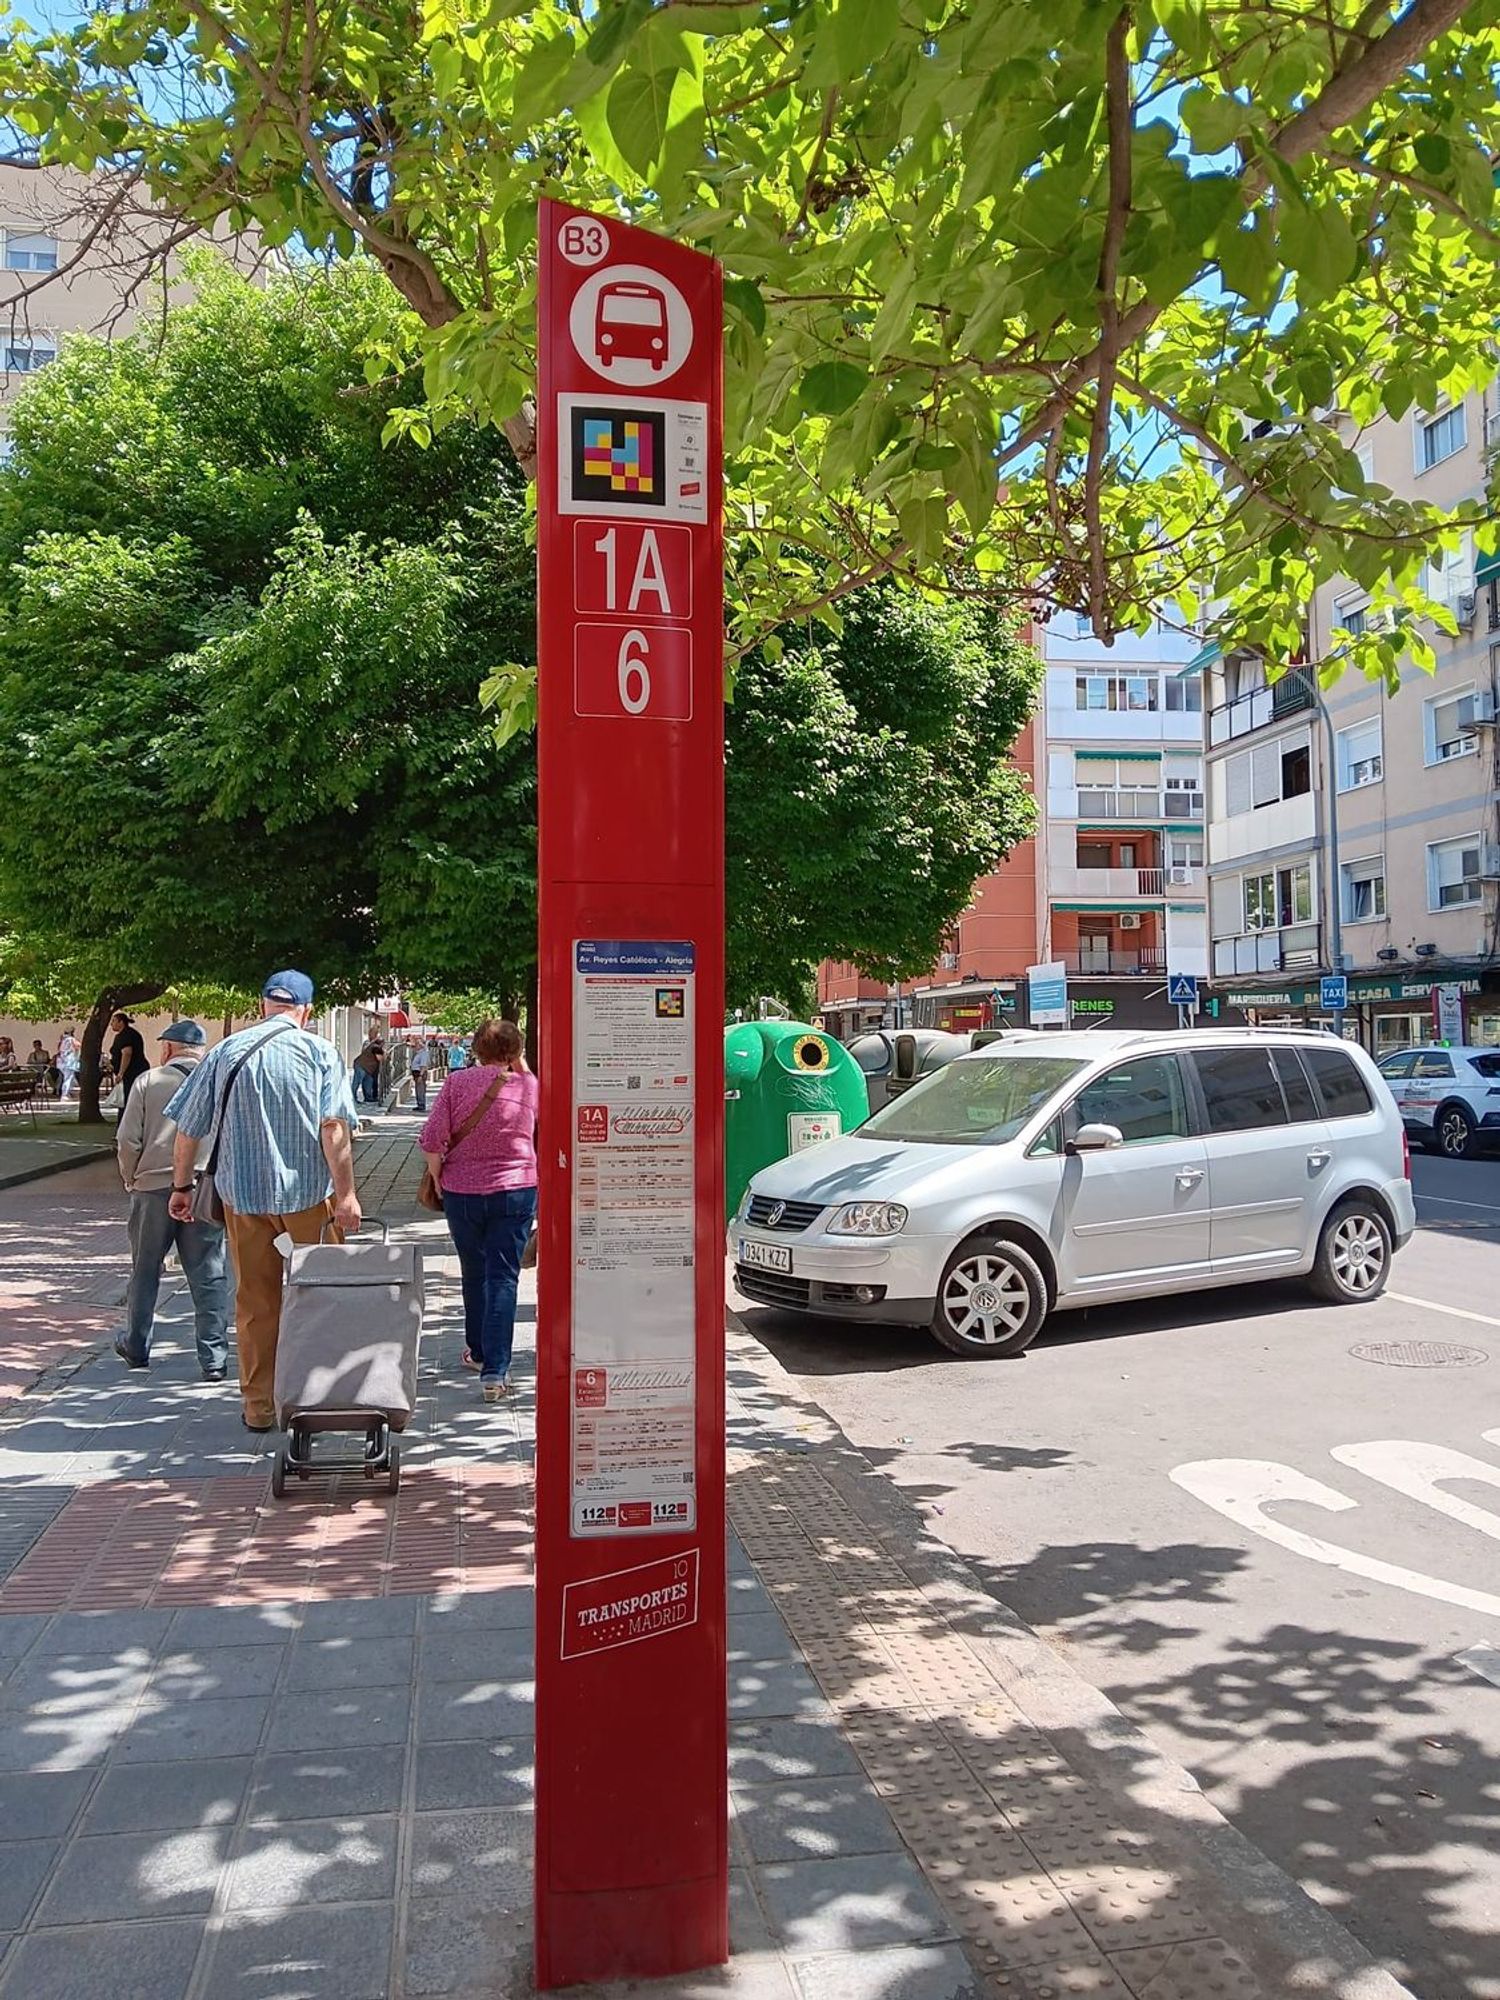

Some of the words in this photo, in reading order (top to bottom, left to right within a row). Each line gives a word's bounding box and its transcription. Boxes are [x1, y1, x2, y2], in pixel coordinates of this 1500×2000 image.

[564, 226, 603, 257] B3
[594, 527, 671, 614] 1A
[617, 629, 651, 715] 6
[593, 956, 618, 965] Reyes
[620, 956, 658, 964] Católicos
[1323, 988, 1344, 998] TAXI
[1358, 987, 1392, 999] CASA
[583, 1109, 603, 1121] 1A
[745, 1243, 766, 1263] 0341
[769, 1248, 787, 1268] KZZ
[586, 1371, 596, 1385] 6
[581, 1508, 605, 1519] 112
[653, 1503, 677, 1515] 112
[577, 1581, 688, 1627] TRANSPORTES
[628, 1603, 687, 1636] MADRID
